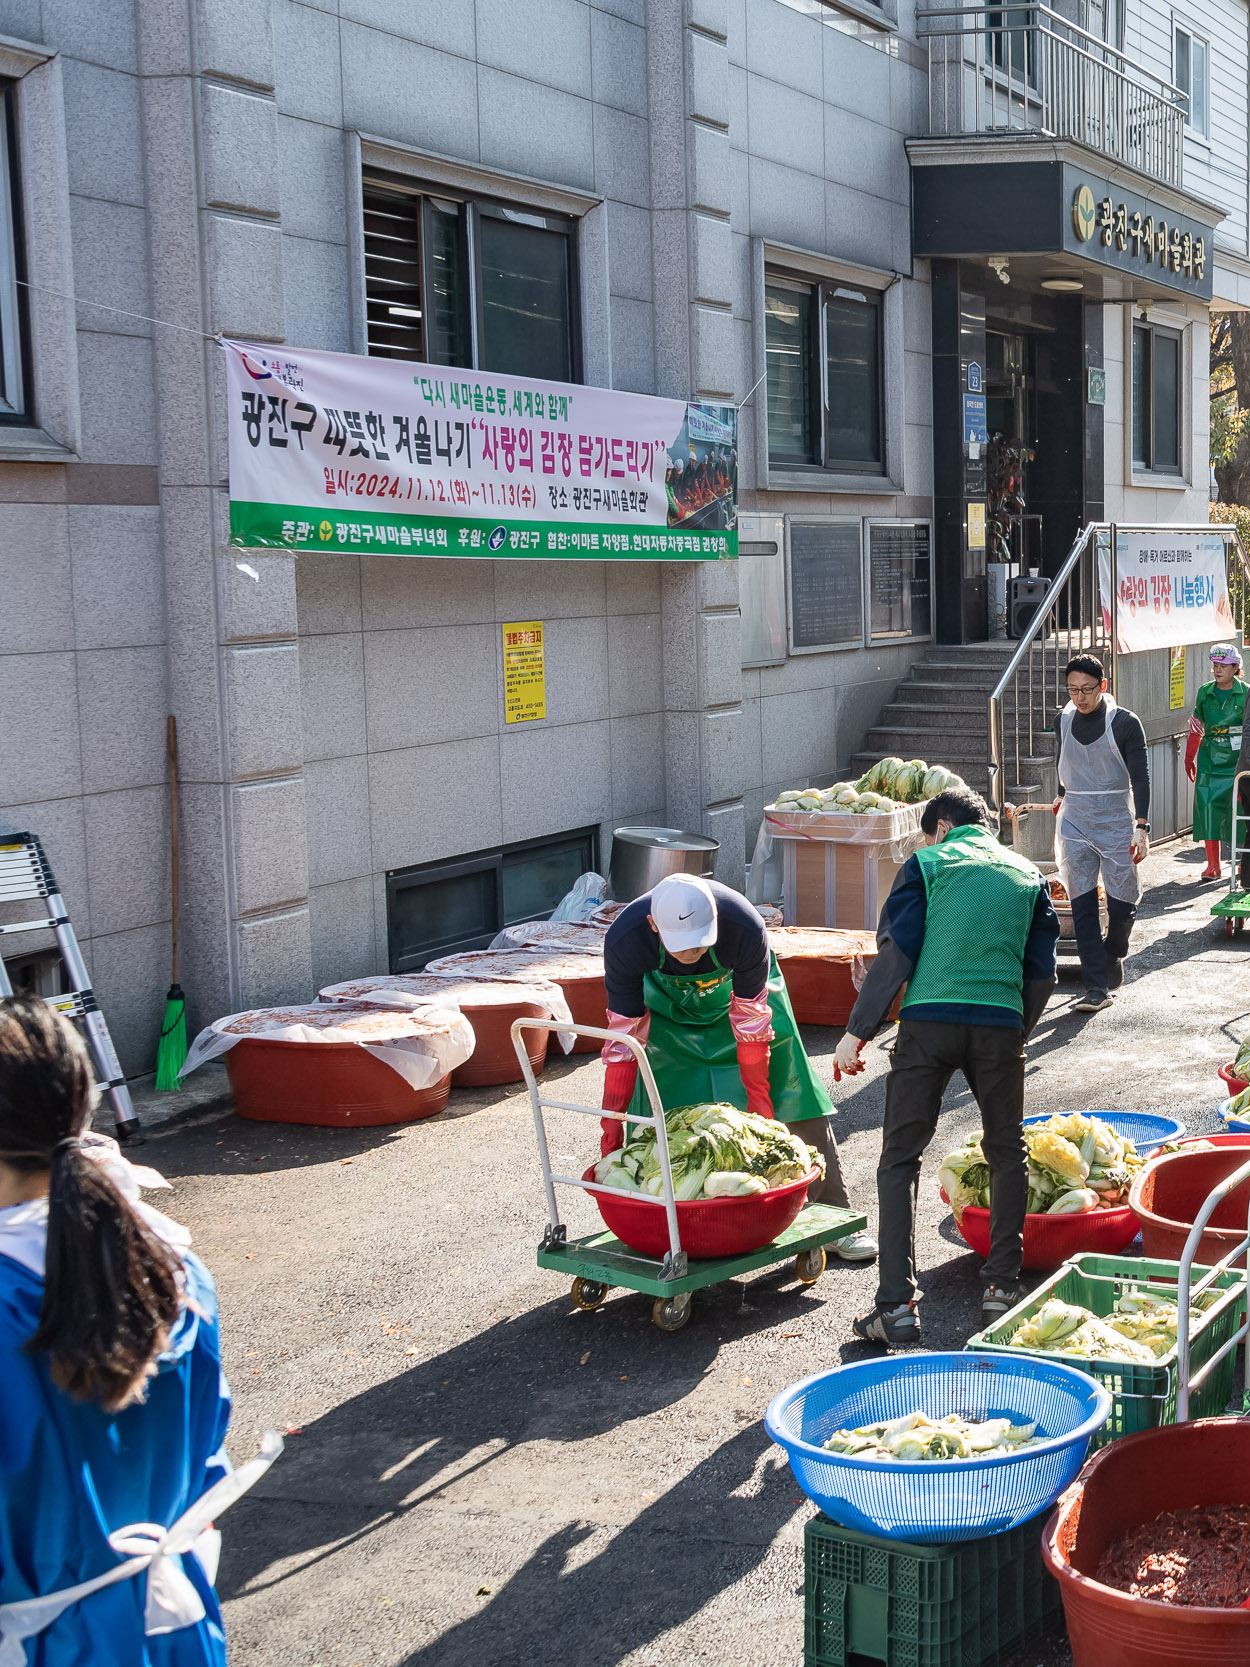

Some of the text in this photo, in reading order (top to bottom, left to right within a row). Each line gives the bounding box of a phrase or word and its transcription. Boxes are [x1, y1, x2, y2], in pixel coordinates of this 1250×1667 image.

[1099, 196, 1206, 281] 광진구새마을회관
[974, 376, 979, 388] 23
[242, 391, 317, 450] 광진구
[322, 407, 390, 461] 따뜻한
[540, 430, 573, 478] 김장
[281, 520, 315, 543] 주관:
[336, 522, 448, 548] 광진구새마을부녀회
[458, 528, 486, 546] 후원:
[509, 531, 540, 549] 광진구
[1151, 575, 1171, 614] 김장
[1174, 575, 1214, 608] 나눔행사
[506, 631, 541, 646] 불법주차금지
